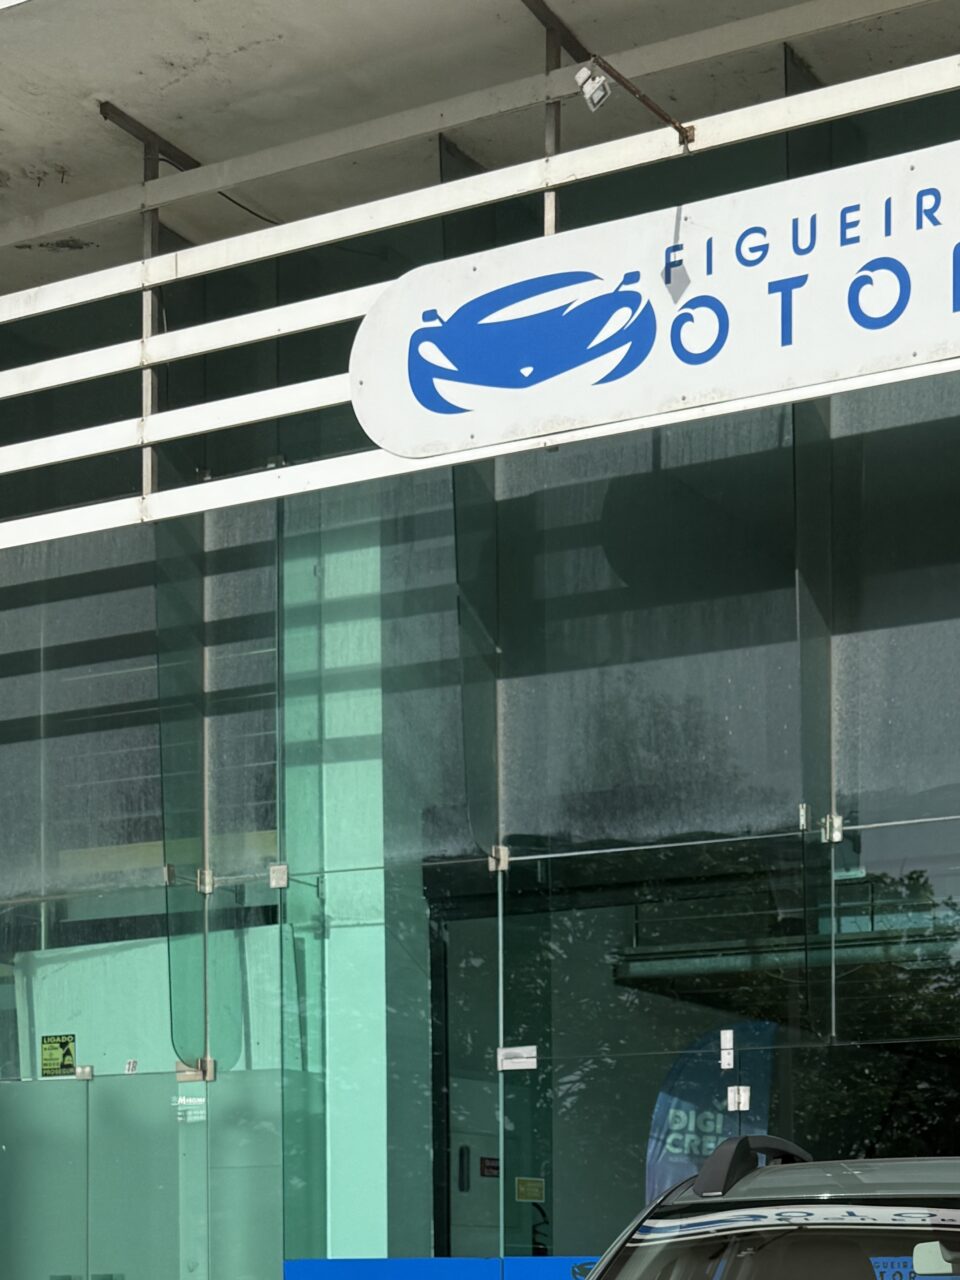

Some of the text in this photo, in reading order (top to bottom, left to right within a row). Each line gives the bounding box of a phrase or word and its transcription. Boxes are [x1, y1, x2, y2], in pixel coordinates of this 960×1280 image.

[43, 1035, 74, 1044] LIGADO
[668, 1108, 724, 1135] DIGI
[665, 1132, 728, 1156] CRE
